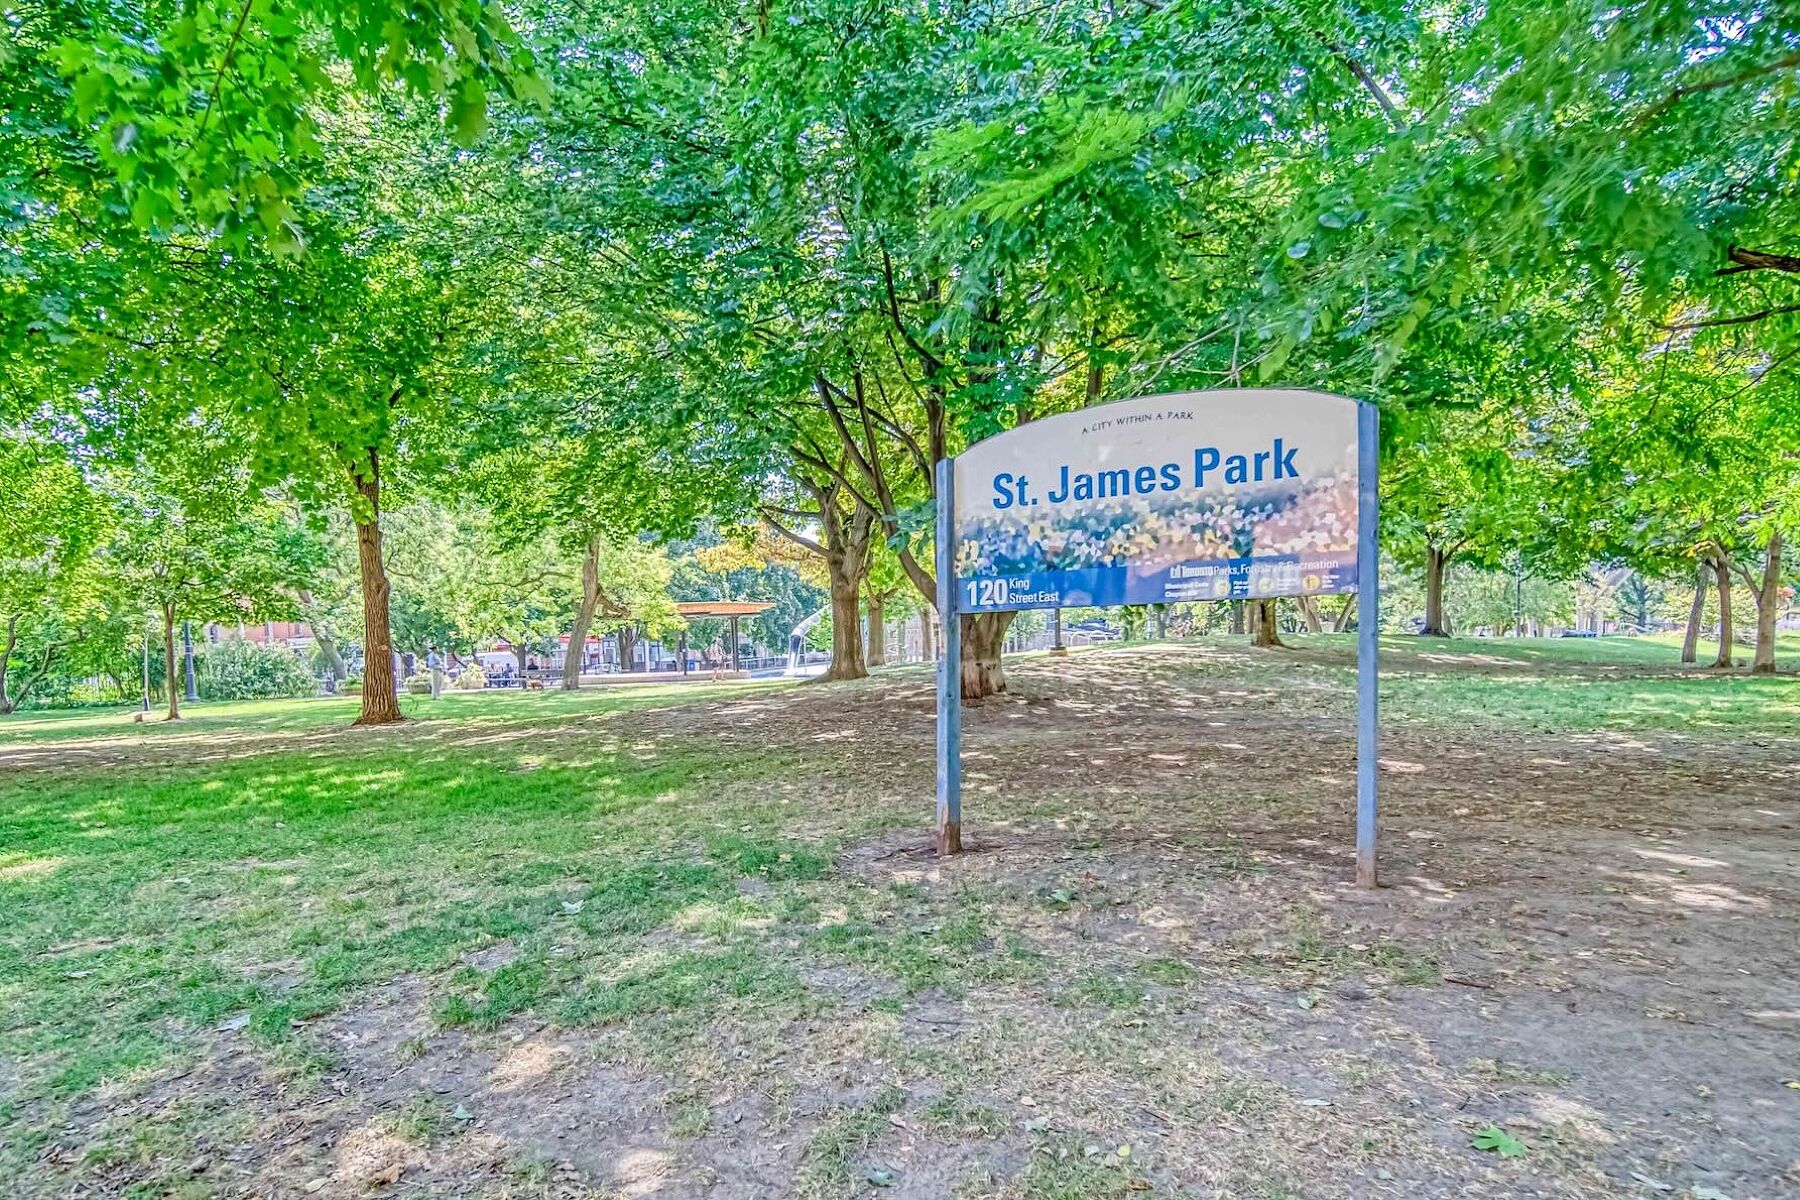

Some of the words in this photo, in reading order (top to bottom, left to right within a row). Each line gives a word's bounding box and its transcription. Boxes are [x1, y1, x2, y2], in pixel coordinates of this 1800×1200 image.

[1091, 420, 1112, 431] CITY
[1116, 414, 1152, 425] WITHIN
[1167, 411, 1193, 420] PARK
[992, 472, 1038, 510] St.
[1048, 462, 1181, 504] James
[1194, 438, 1300, 488] Park
[1214, 565, 1240, 576] Parks,
[1286, 559, 1339, 571] Recreation
[967, 579, 1008, 606] 120
[1009, 578, 1030, 590] King
[1009, 592, 1038, 604] Street
[1038, 591, 1059, 602] East
